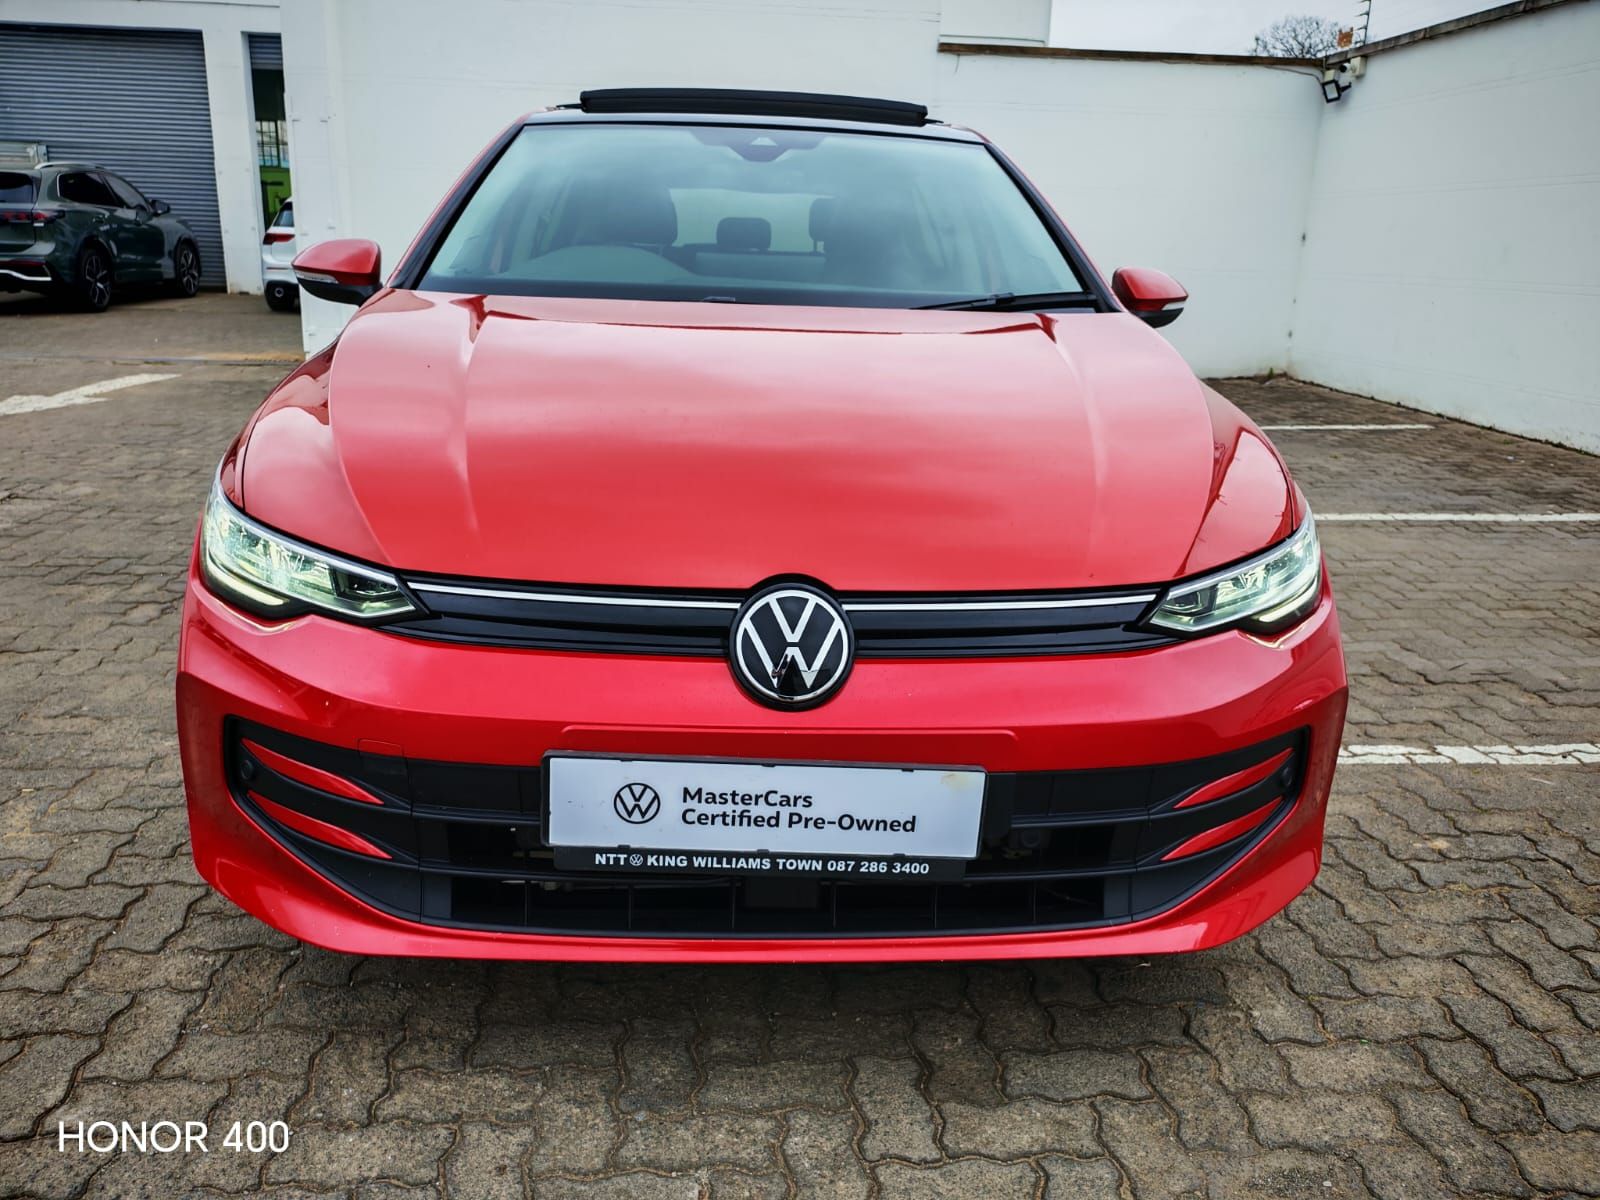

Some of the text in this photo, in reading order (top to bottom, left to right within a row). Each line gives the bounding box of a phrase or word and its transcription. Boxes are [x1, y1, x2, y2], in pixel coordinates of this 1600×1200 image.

[682, 786, 813, 808] MasterCars
[681, 808, 916, 833] Certified Pre-Owned
[595, 853, 627, 866] NTT
[647, 854, 688, 867] KING
[692, 855, 771, 870] WILLIAMS
[776, 858, 823, 871] TOWN
[827, 860, 855, 872] 087
[859, 861, 887, 873] 286
[891, 862, 930, 874] 3400
